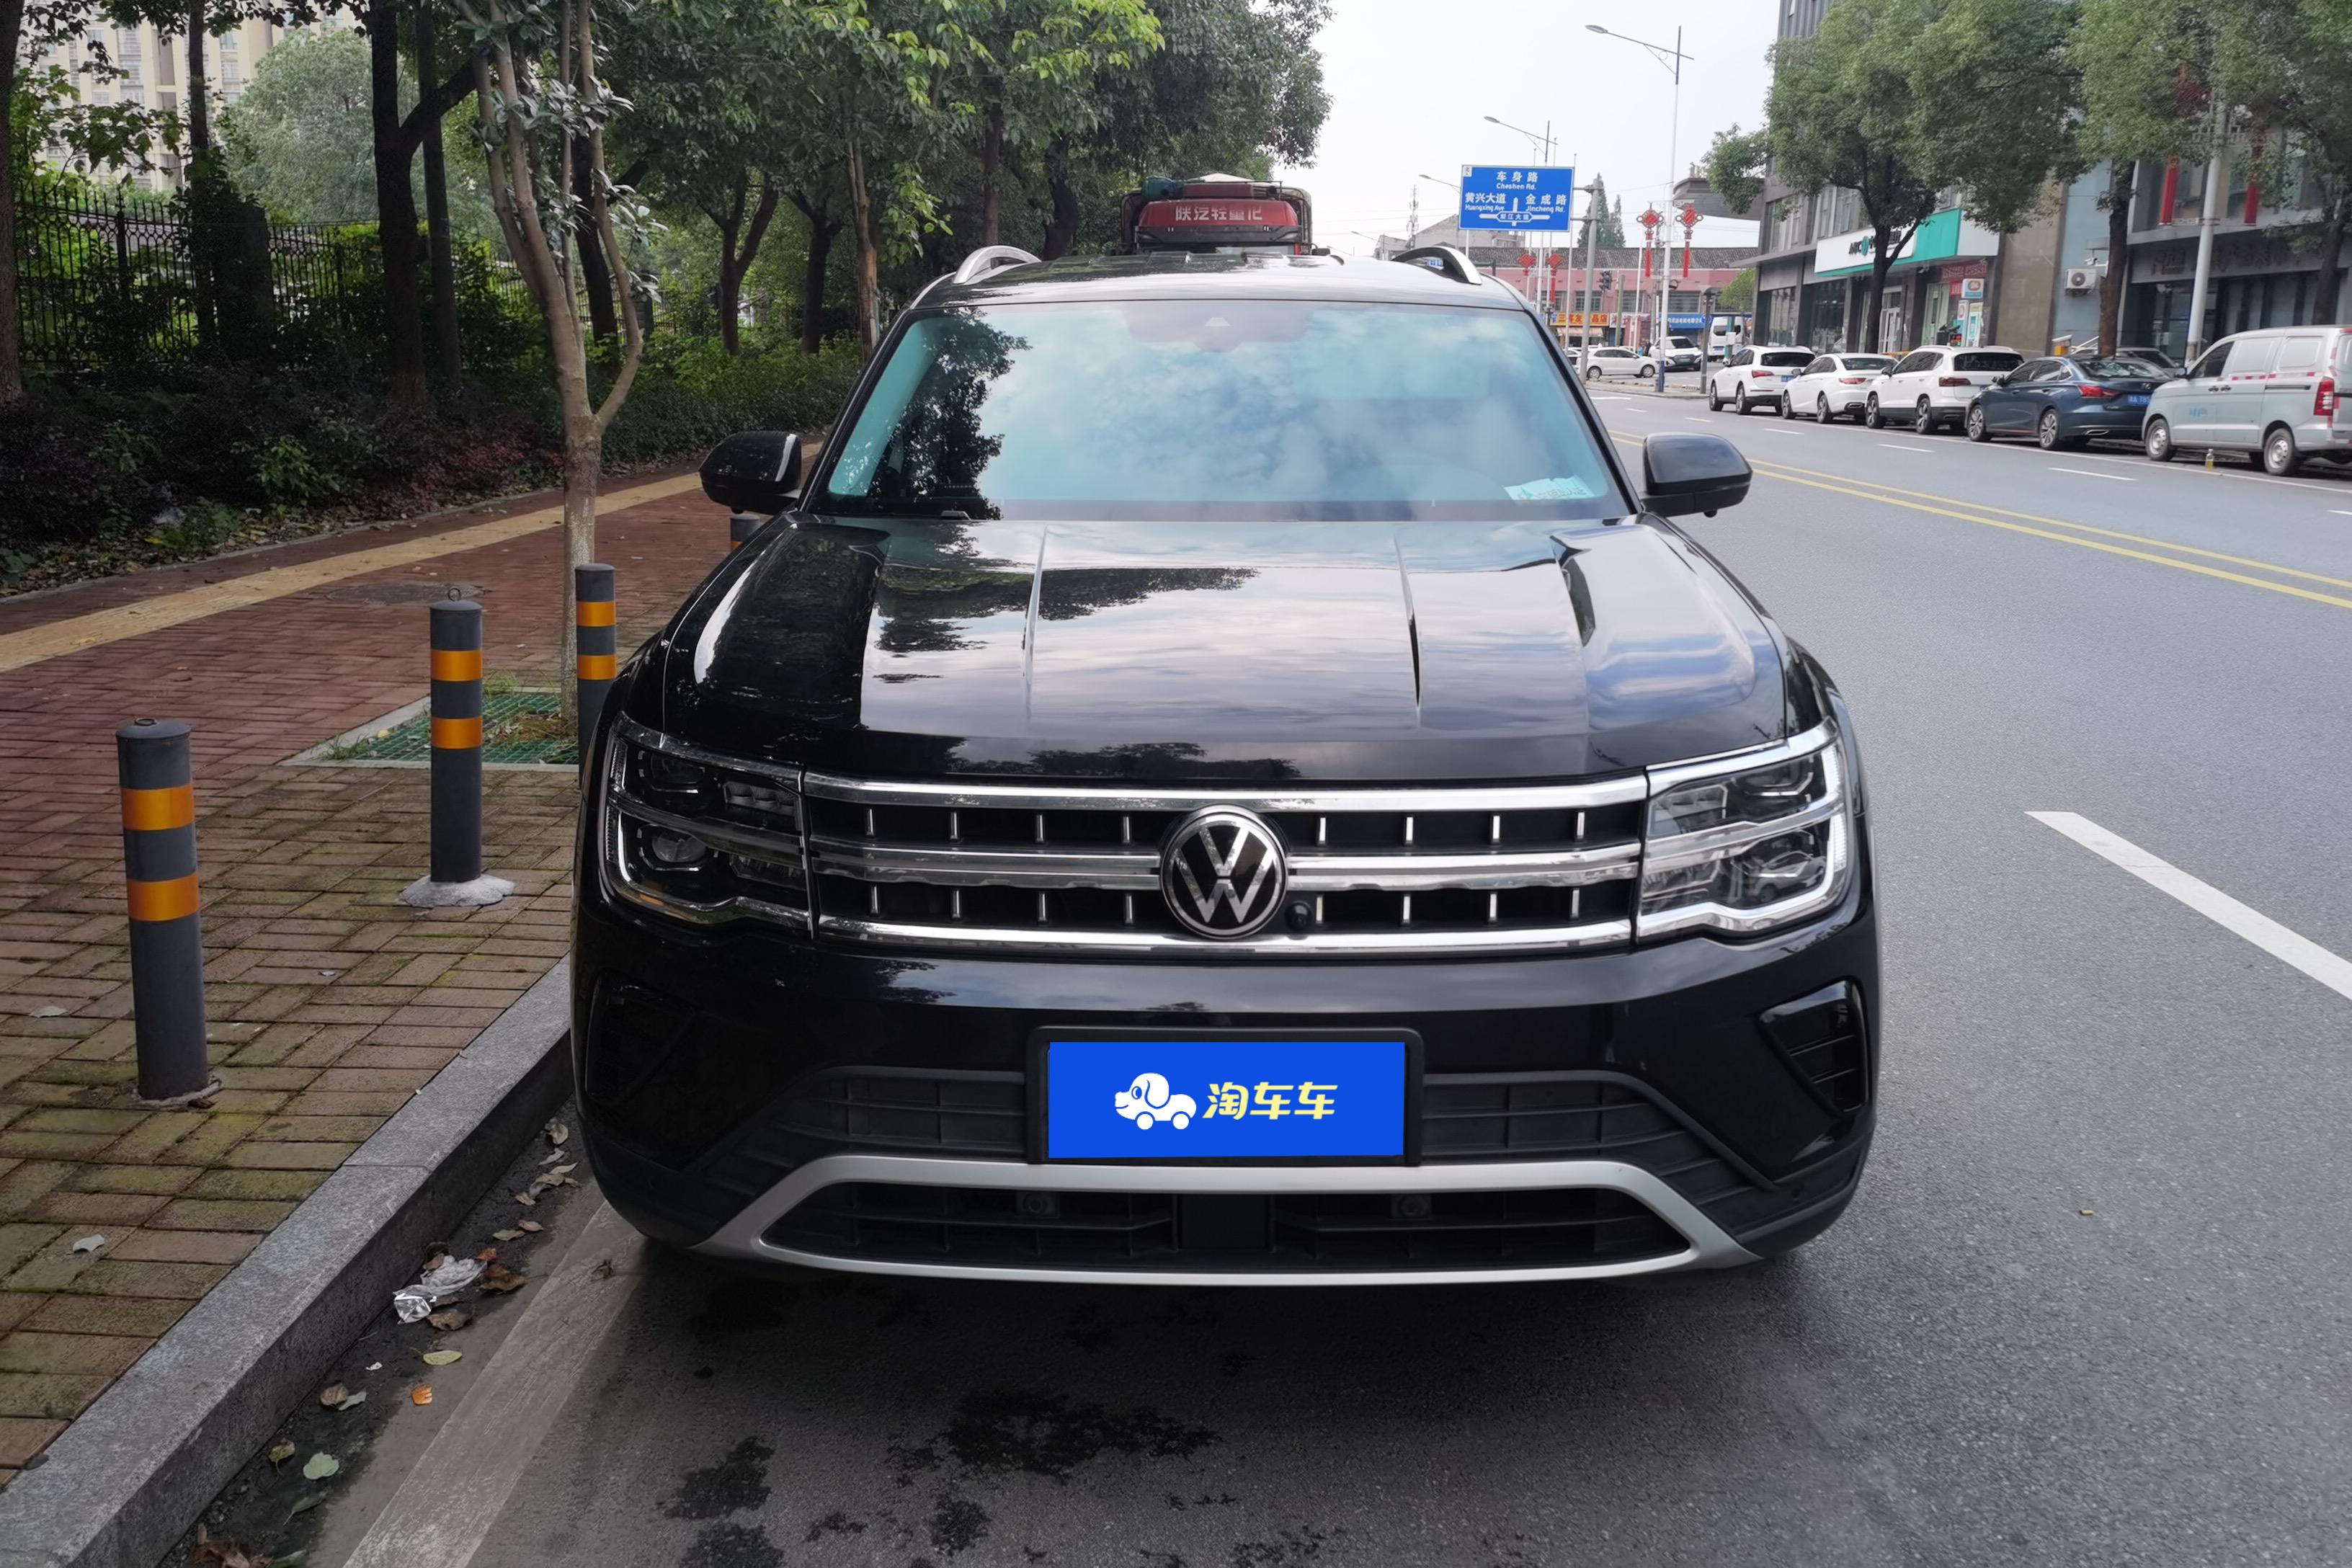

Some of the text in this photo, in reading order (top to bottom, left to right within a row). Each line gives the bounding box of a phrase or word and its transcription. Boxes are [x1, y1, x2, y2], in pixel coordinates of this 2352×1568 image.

[1496, 170, 1538, 183] 车身路
[1465, 192, 1506, 204] 黄兴大道
[1525, 193, 1567, 205] 金成路
